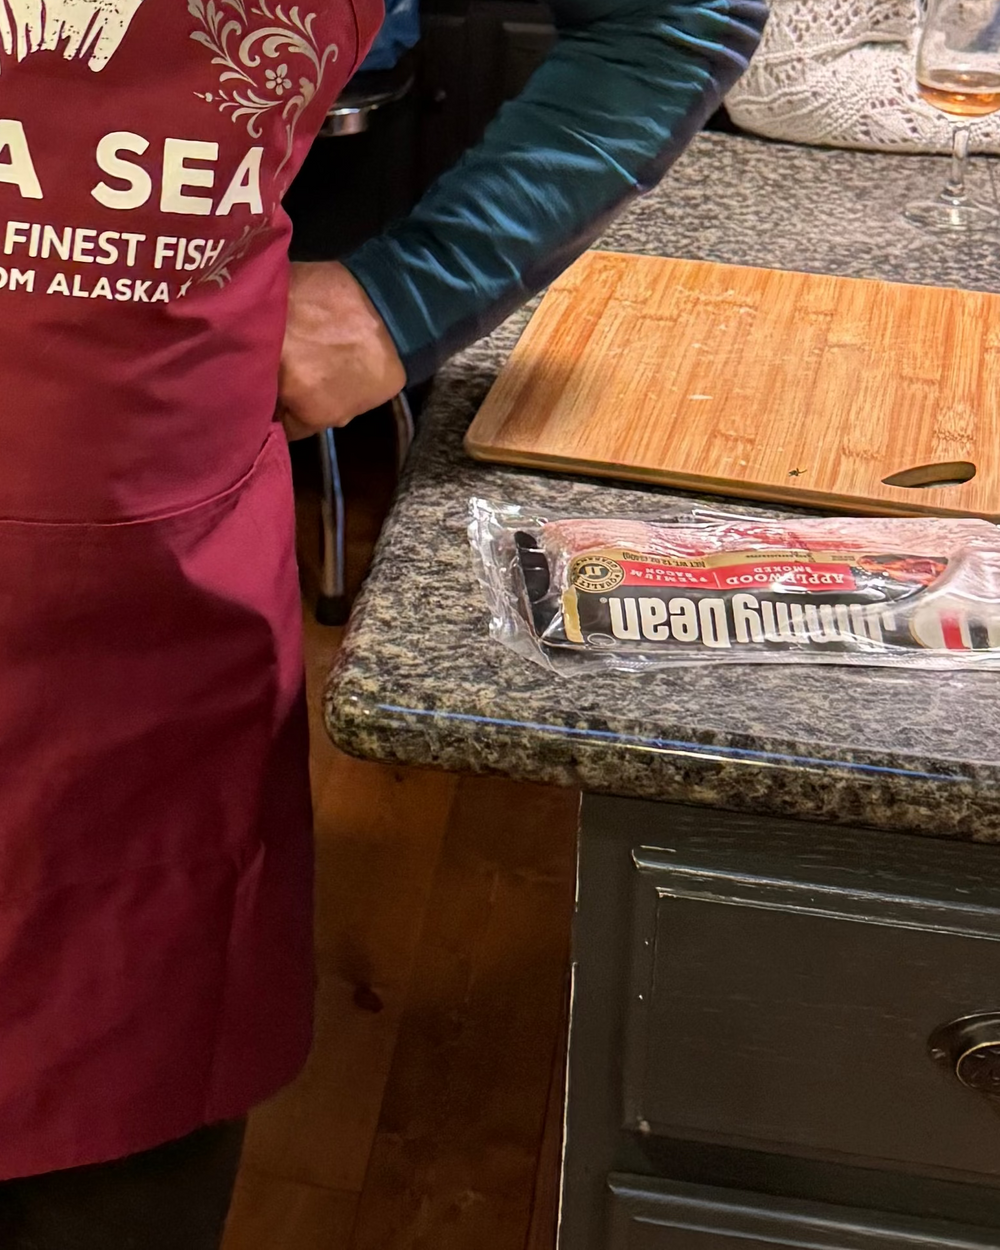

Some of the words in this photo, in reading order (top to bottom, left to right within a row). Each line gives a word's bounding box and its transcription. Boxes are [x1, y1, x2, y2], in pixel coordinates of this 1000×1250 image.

[91, 131, 264, 216] SEA
[4, 221, 146, 268] FINEST
[154, 234, 225, 271] FISH
[46, 276, 171, 304] ALASKA
[629, 569, 708, 584] PREMIUM
[645, 567, 693, 579] BACON
[753, 564, 813, 574] SMOKED
[608, 597, 732, 649] Dean
